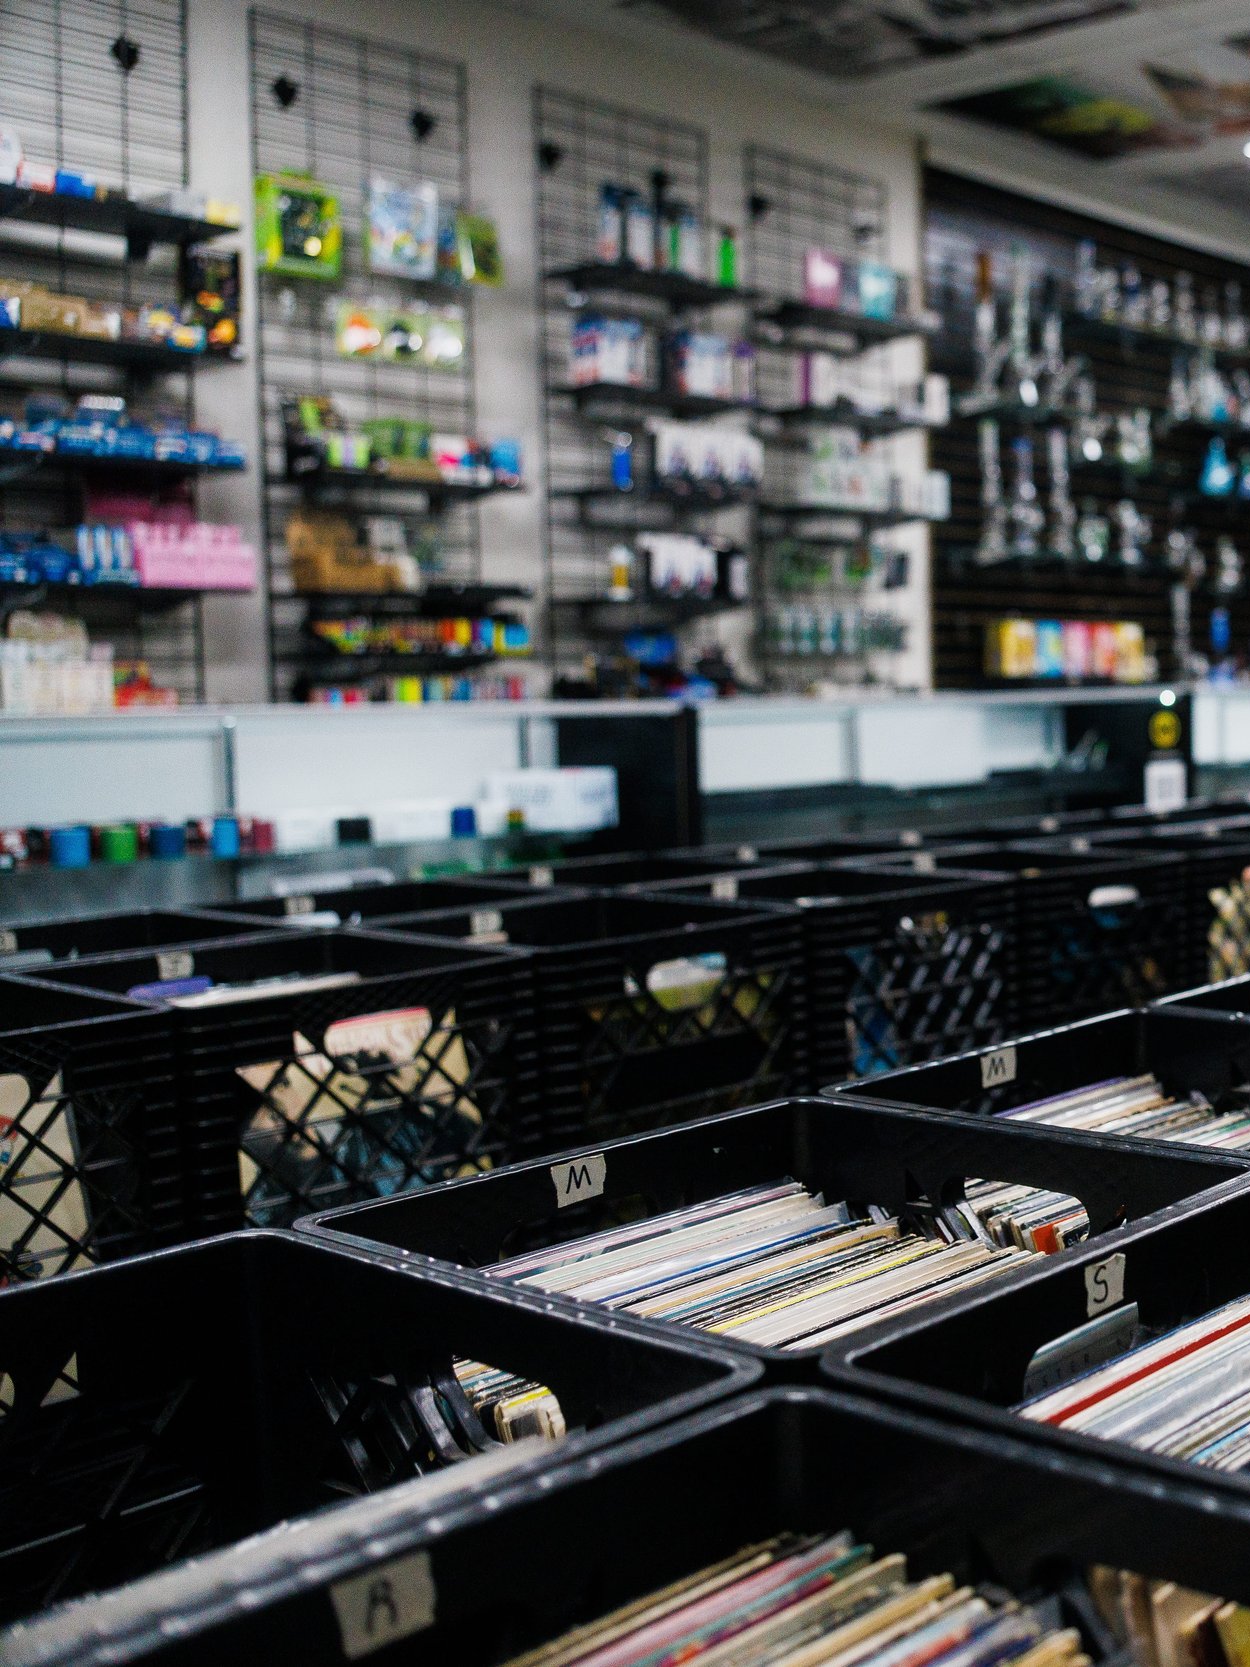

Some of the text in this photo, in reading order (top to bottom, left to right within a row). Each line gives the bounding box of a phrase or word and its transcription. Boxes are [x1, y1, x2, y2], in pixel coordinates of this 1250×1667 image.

[986, 1057, 1007, 1080] M
[565, 1164, 592, 1195] M
[1093, 1265, 1108, 1303] S
